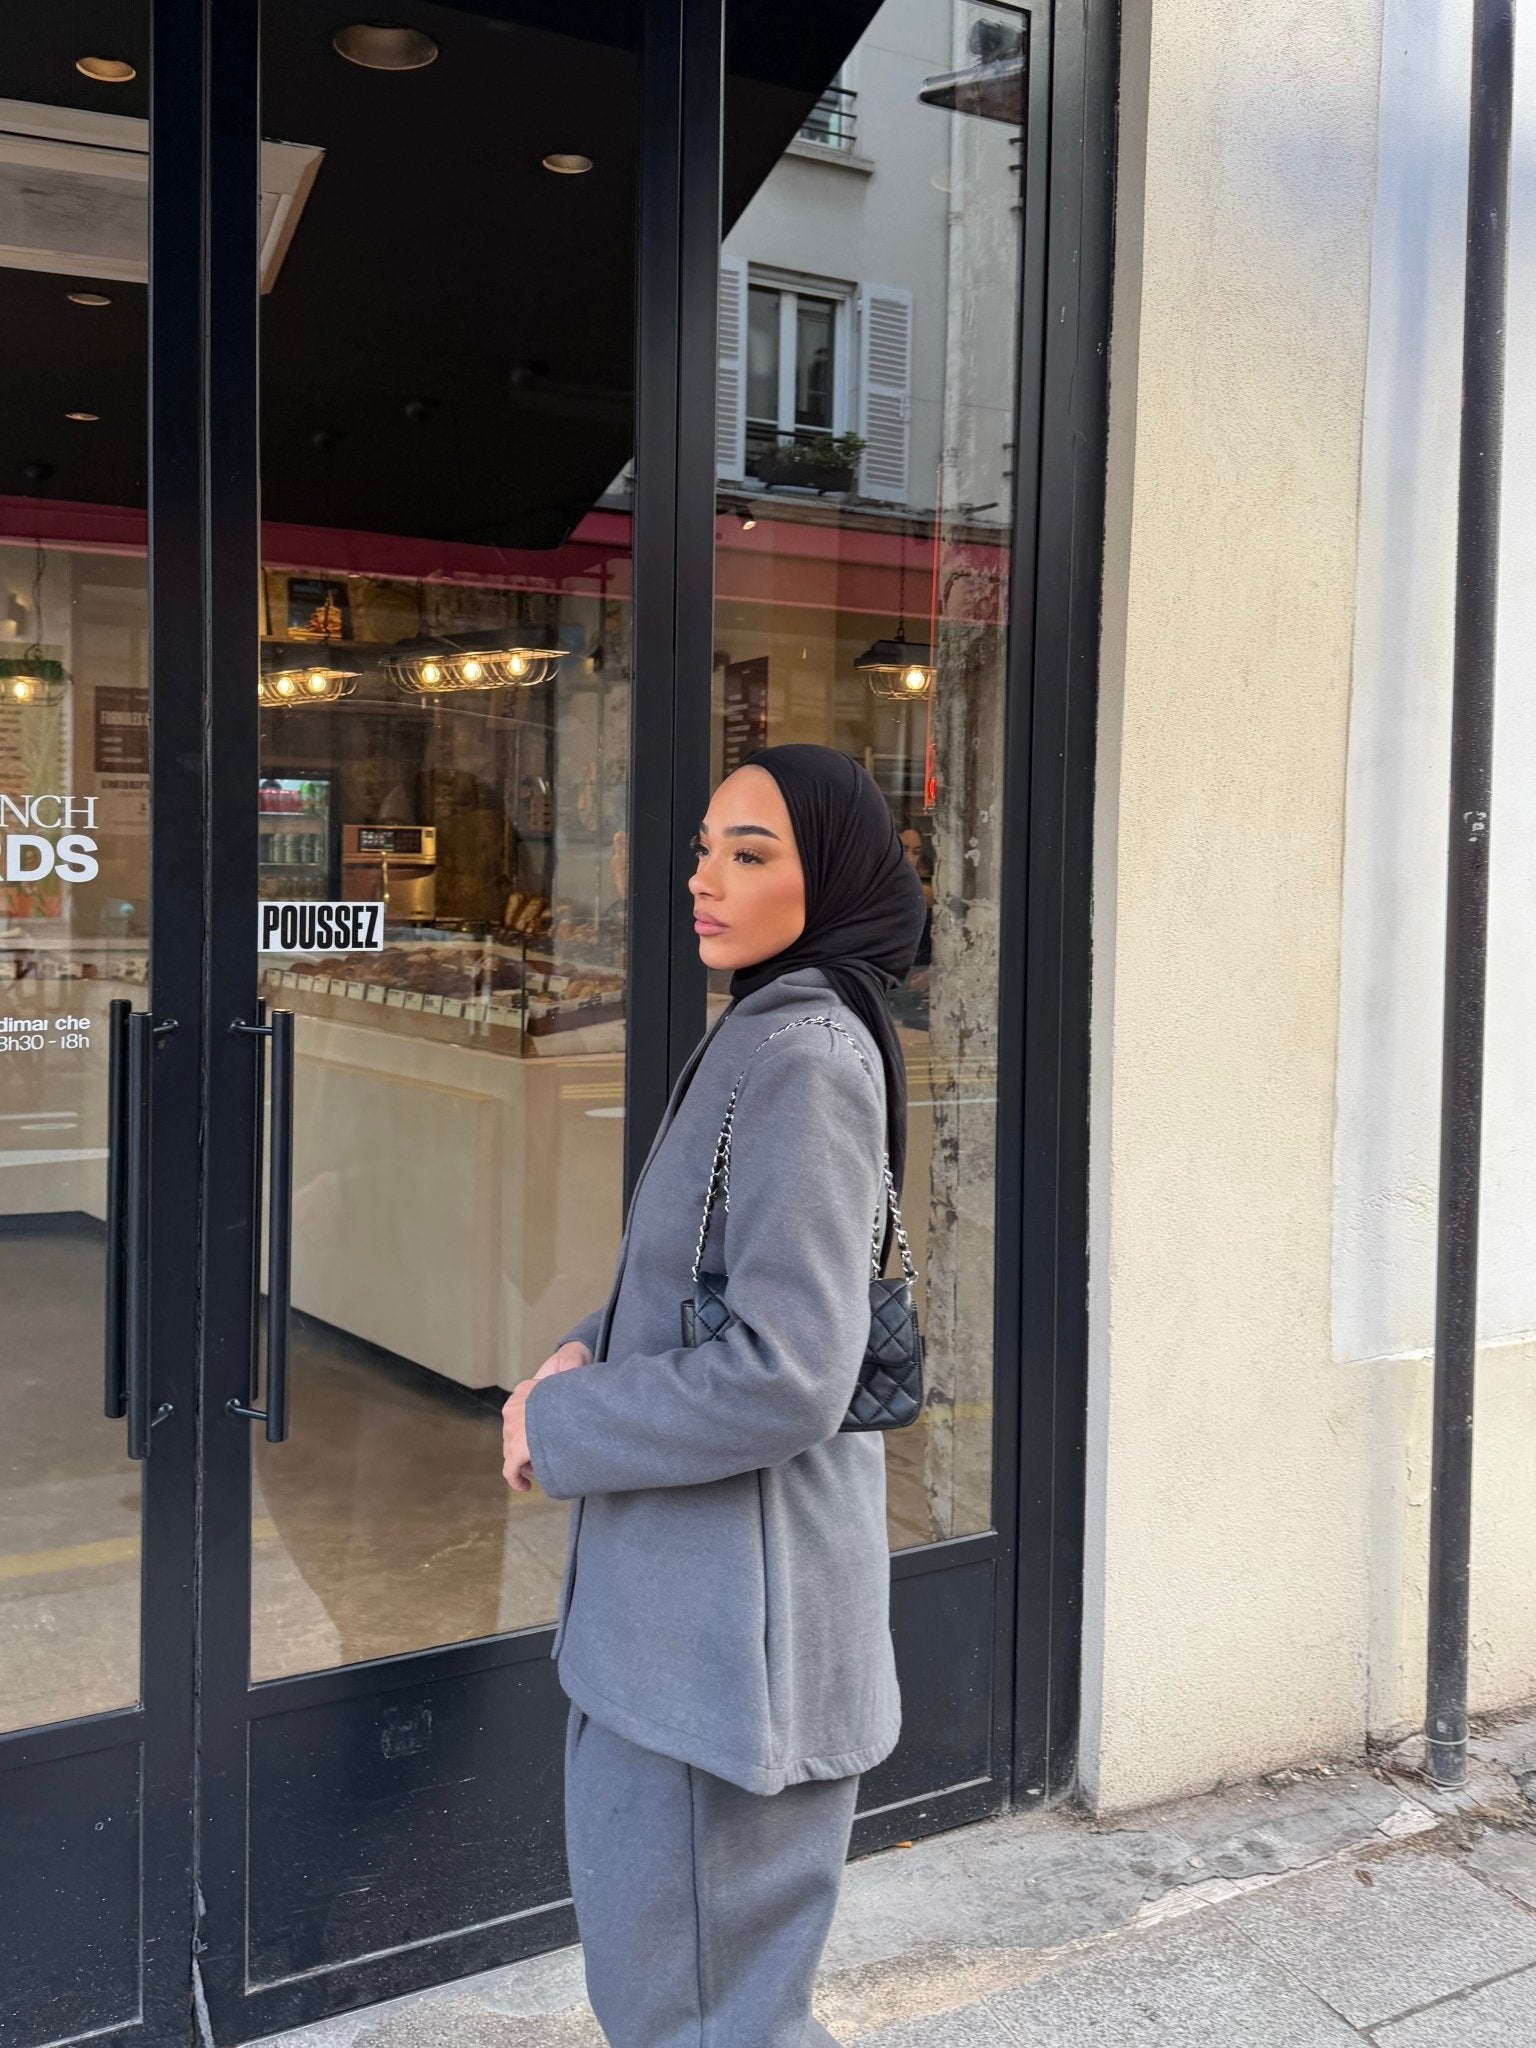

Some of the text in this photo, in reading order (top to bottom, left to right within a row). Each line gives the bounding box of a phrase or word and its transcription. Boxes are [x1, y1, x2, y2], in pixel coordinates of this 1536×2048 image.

[0, 794, 99, 829] NCH
[0, 834, 99, 883] DS
[263, 905, 379, 950] POUSSEZ
